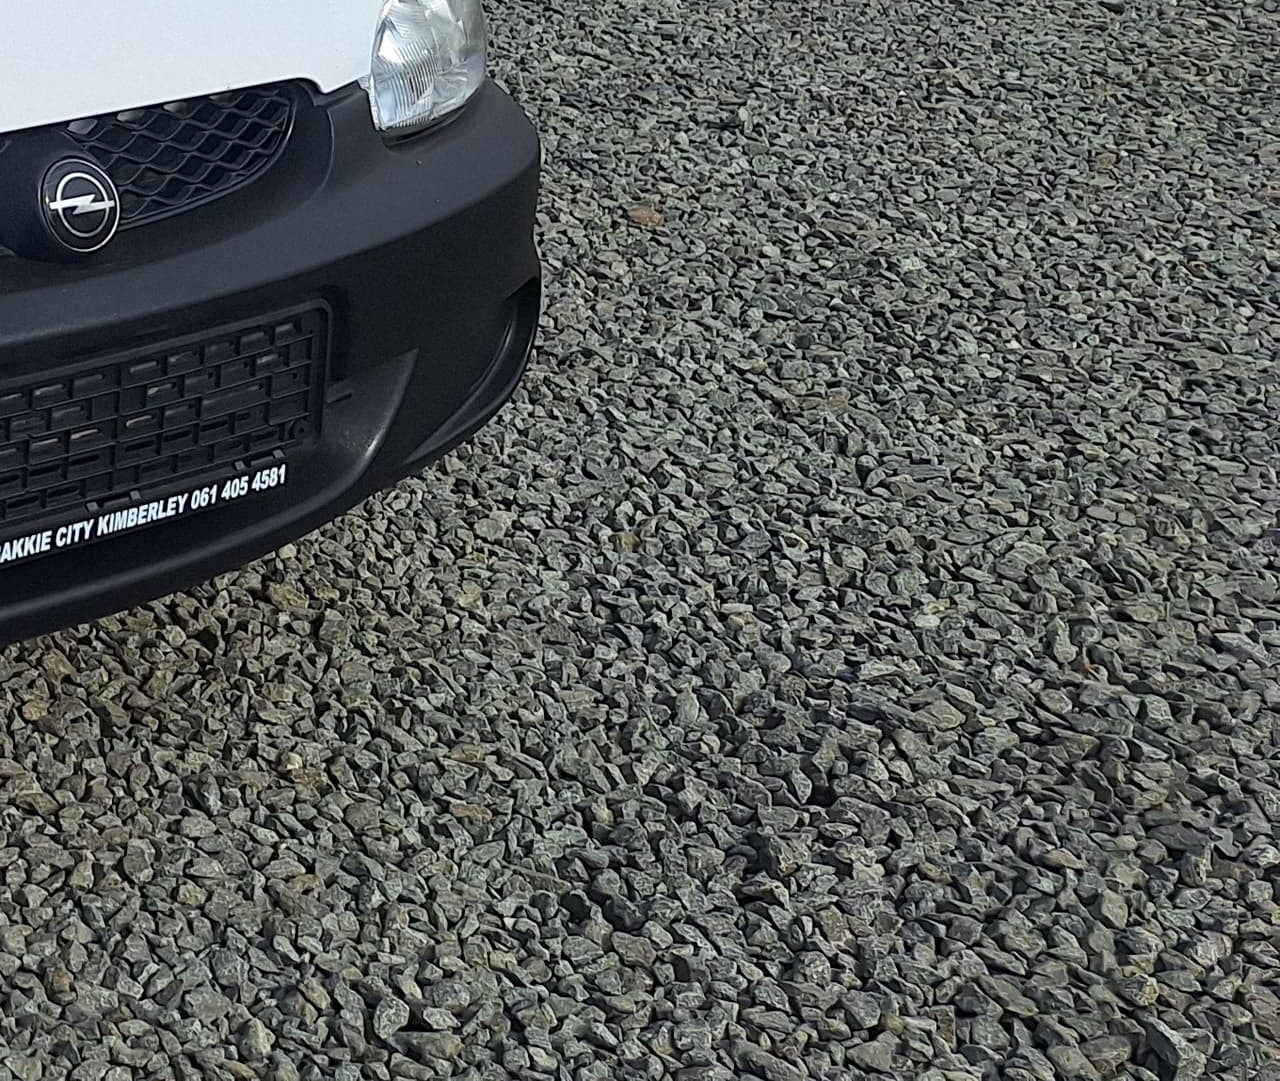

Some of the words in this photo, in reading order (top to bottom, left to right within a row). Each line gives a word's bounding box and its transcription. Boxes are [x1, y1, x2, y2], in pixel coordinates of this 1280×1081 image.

[55, 519, 95, 547] CITY
[96, 493, 189, 536] KIMBERLEY
[190, 484, 218, 510] 061
[221, 475, 249, 500] 405
[251, 464, 286, 491] 4581
